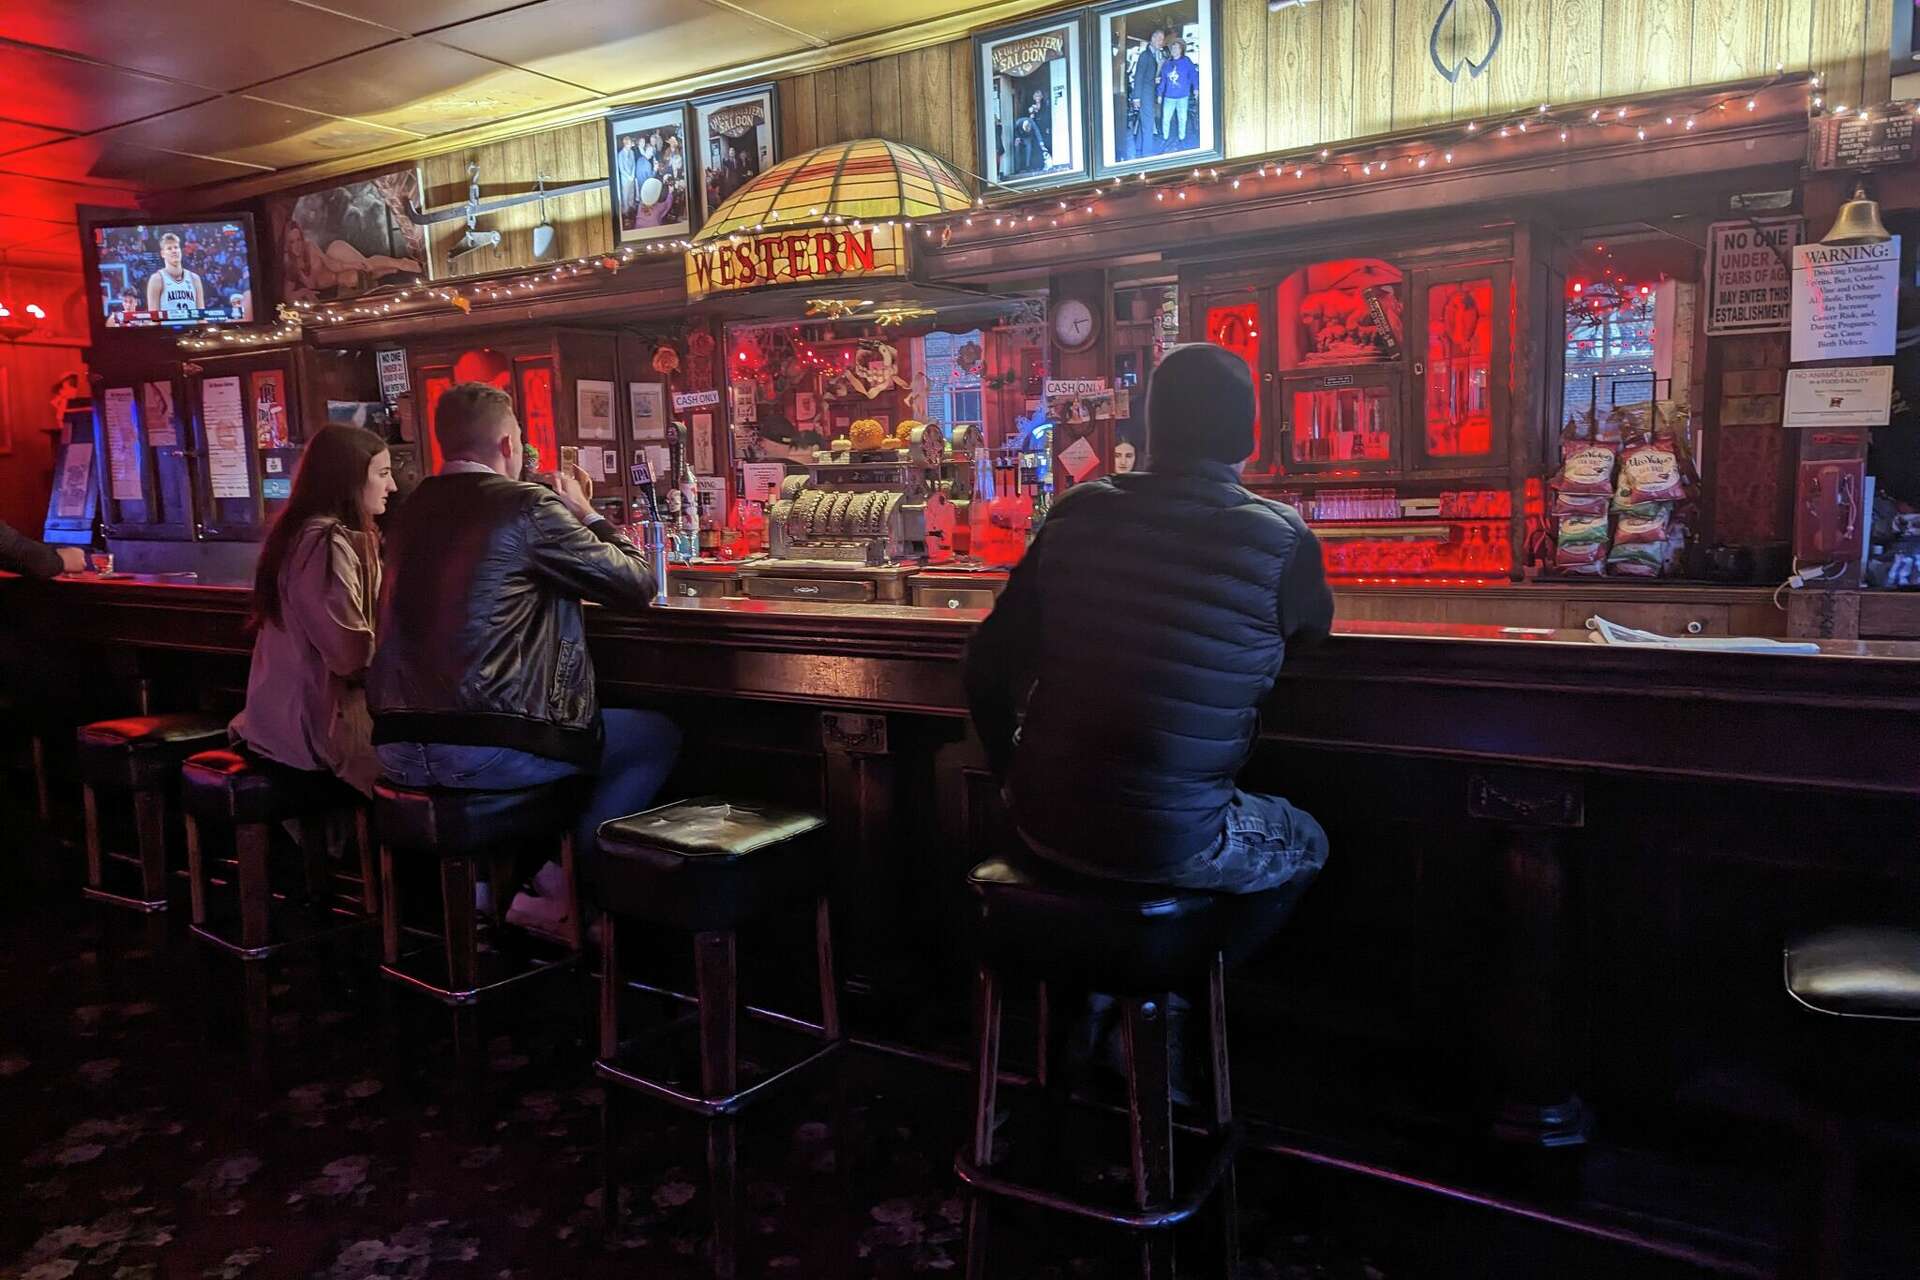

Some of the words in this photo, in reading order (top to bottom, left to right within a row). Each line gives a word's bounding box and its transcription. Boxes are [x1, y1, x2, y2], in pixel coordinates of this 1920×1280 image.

[1000, 48, 1047, 72] SALOON
[720, 114, 754, 134] SALOON
[1723, 232, 1748, 250] NO
[1753, 229, 1788, 247] ONE
[693, 230, 875, 290] WESTERN
[1721, 252, 1769, 269] UNDER
[1806, 244, 1889, 264] WARNING:
[1718, 270, 1752, 286] YEARS
[1755, 268, 1769, 282] OF
[1814, 269, 1846, 278] Drinking
[1720, 289, 1740, 305] MAY
[1740, 288, 1767, 304] ENTER
[1769, 286, 1790, 302] THIS
[1852, 284, 1875, 292] Other
[167, 290, 195, 302] ARIZONA
[1845, 293, 1882, 302] Beverages
[1715, 303, 1791, 323] ESTABLISHMENT
[1838, 303, 1868, 311] Increase
[1810, 323, 1836, 332] During
[1817, 340, 1837, 348] Birth
[1078, 382, 1103, 394] ONLY
[699, 392, 717, 404] ONLY
[632, 467, 649, 482] IPA
